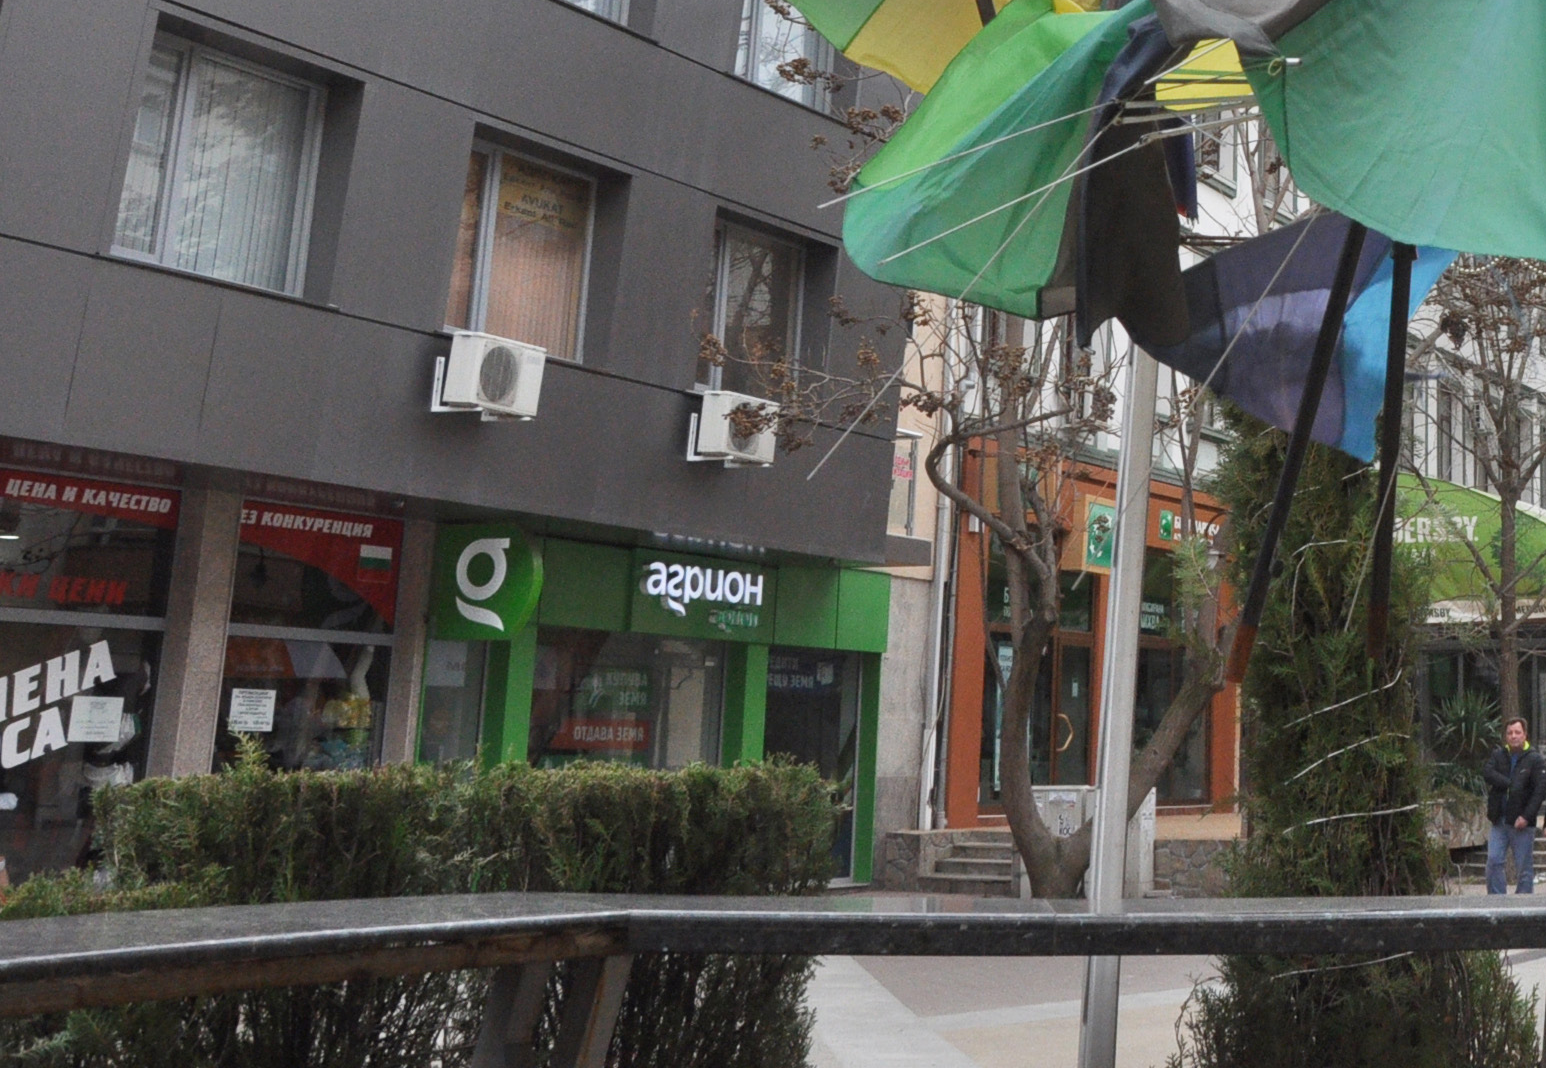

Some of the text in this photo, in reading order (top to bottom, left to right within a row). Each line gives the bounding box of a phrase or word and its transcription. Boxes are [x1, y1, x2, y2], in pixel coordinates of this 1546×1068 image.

[5, 478, 172, 514] ЦЕНА И КАЧЕСТВО
[260, 511, 374, 539] КОНКУРЕНЦИЯ
[618, 691, 648, 706] ЗЕМЯ
[573, 725, 644, 743] ОТДАВА ЗЕМЯ
